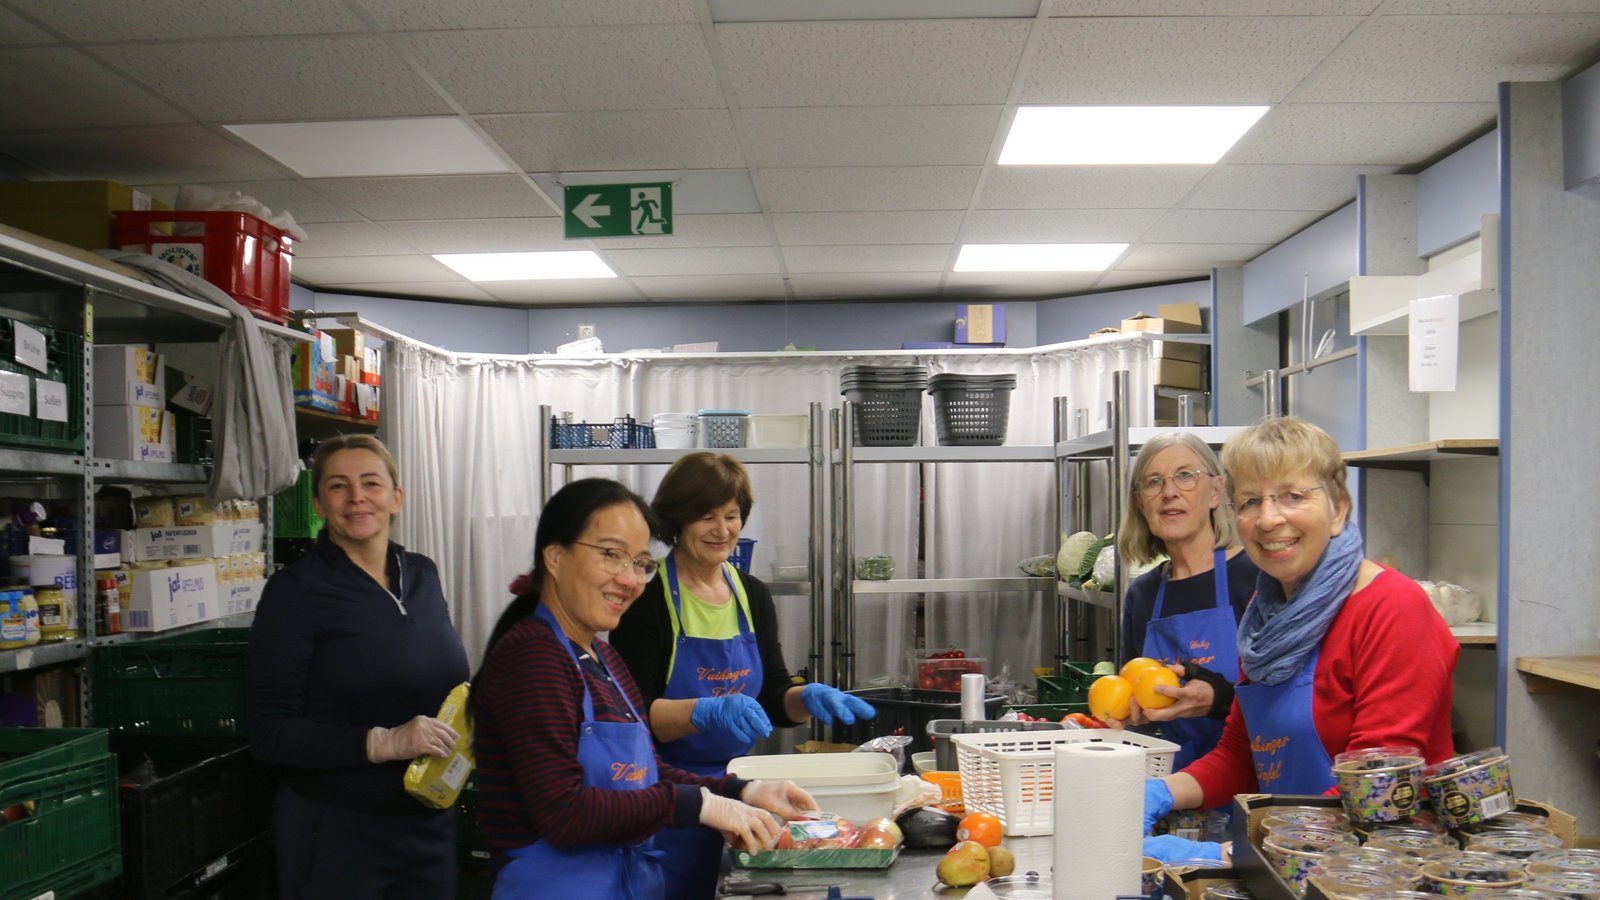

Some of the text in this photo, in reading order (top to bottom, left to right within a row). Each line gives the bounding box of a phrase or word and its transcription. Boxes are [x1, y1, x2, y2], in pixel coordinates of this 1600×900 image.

[150, 530, 163, 543] ja!
[54, 576, 77, 590] BEB
[167, 572, 181, 603] ja!
[696, 666, 752, 684] Vaihinger
